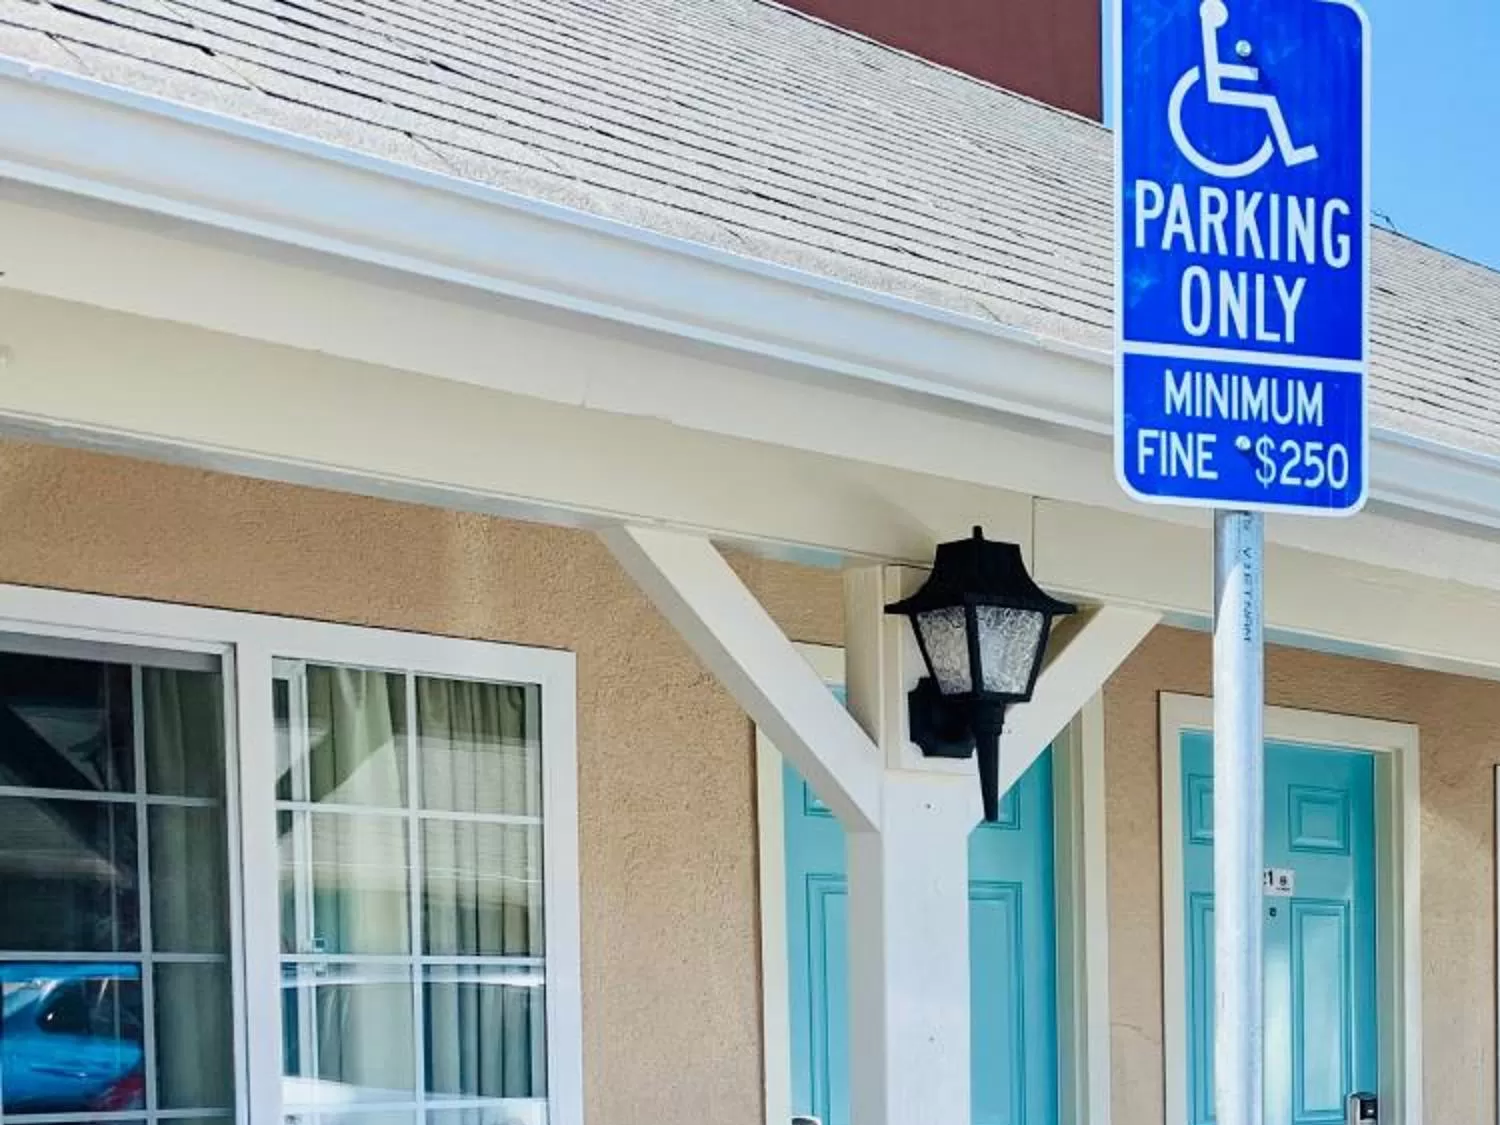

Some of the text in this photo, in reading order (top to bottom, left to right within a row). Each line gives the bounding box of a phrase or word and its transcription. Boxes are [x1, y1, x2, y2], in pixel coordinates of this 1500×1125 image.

[1135, 179, 1351, 269] PARKING
[1181, 265, 1307, 343] ONLY
[1164, 368, 1324, 428] MINIMUM
[1137, 428, 1350, 490] FINE $250
